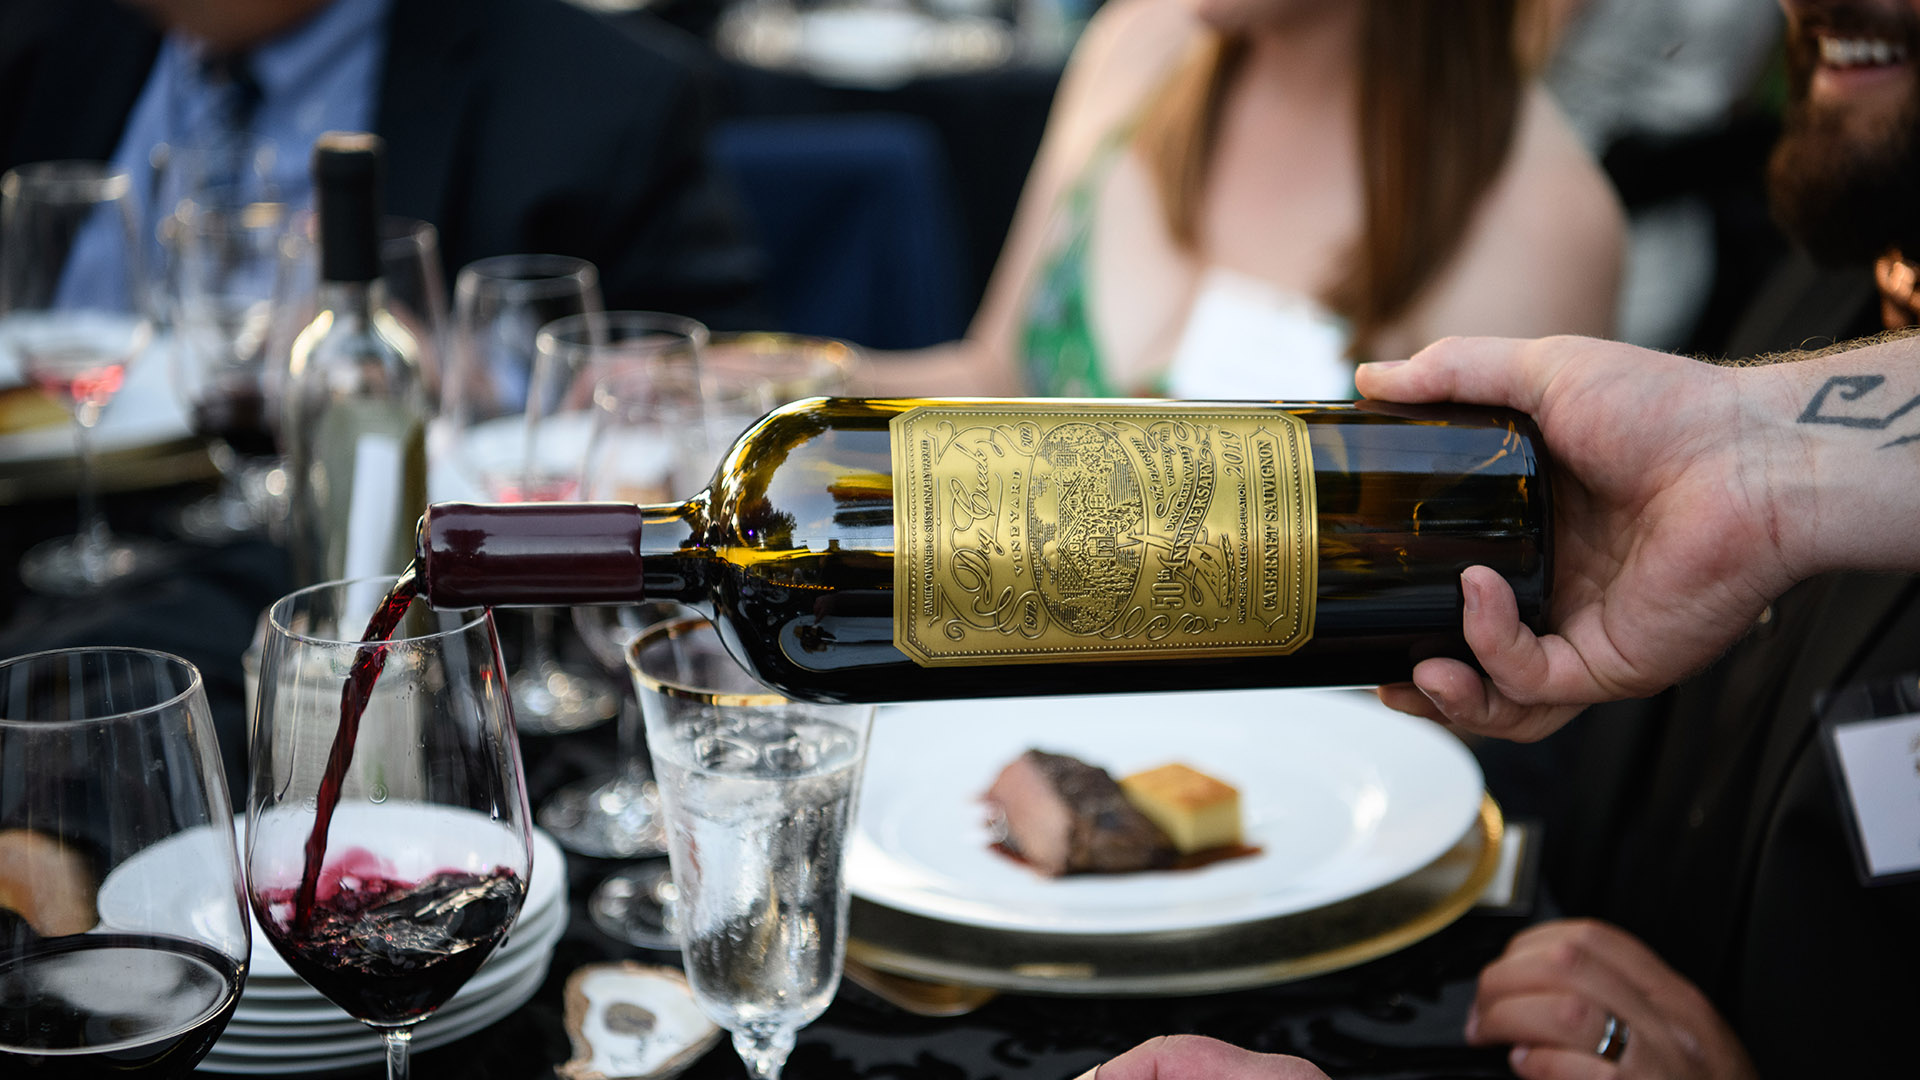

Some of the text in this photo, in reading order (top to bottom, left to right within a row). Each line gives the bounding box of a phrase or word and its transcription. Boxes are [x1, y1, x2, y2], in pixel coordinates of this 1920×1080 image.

[1219, 429, 1245, 480] 2019
[950, 442, 1005, 604] Dry Creek
[1009, 470, 1024, 577] VINEYARD
[1164, 510, 1182, 532] DRY
[1176, 475, 1193, 510] CREEK
[1237, 482, 1248, 542] APPELLATION
[1257, 440, 1279, 612] CABERNET SAUVIGNON
[924, 532, 934, 543] &
[924, 544, 934, 580] OWNED
[1151, 459, 1216, 611] 50th ANNIVERSARY
[1239, 542, 1248, 576] VALLEY
[924, 583, 934, 616] FAMILY
[1024, 601, 1037, 630] 1972
